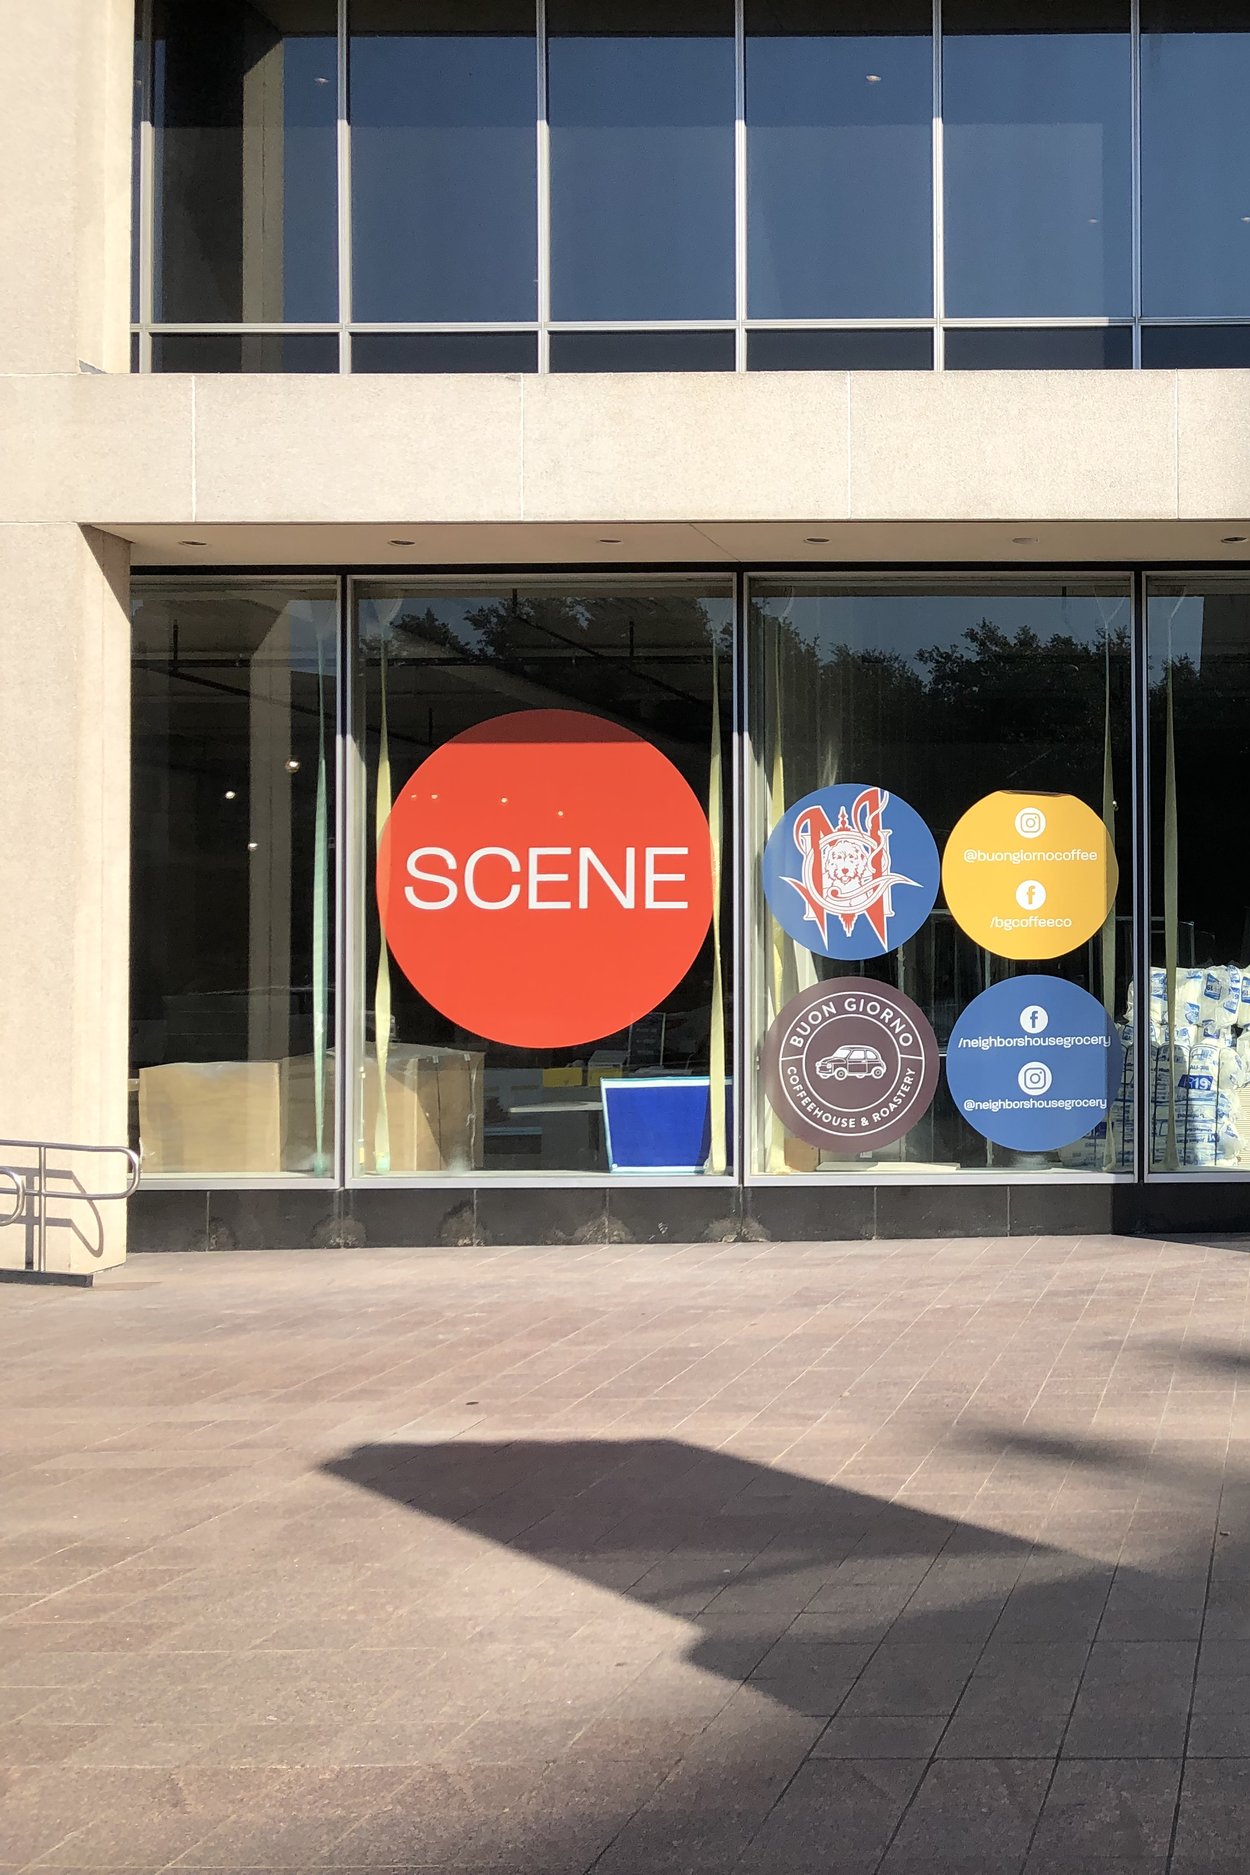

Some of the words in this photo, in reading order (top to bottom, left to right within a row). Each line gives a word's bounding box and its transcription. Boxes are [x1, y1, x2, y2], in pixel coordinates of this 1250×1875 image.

[963, 847, 1098, 865] @buongiornocoffee
[404, 846, 689, 911] SCENE
[990, 914, 1073, 931] /bgcoffeeco
[789, 1001, 837, 1048] BUON
[844, 997, 914, 1047] GIORNO
[957, 1034, 1112, 1051] /neighborshousegrocery
[787, 1066, 857, 1128] COFFEEHOUSE
[860, 1116, 870, 1127] &
[871, 1067, 916, 1123] ROASTERY
[963, 1097, 1108, 1112] @neighborshousegrocery
